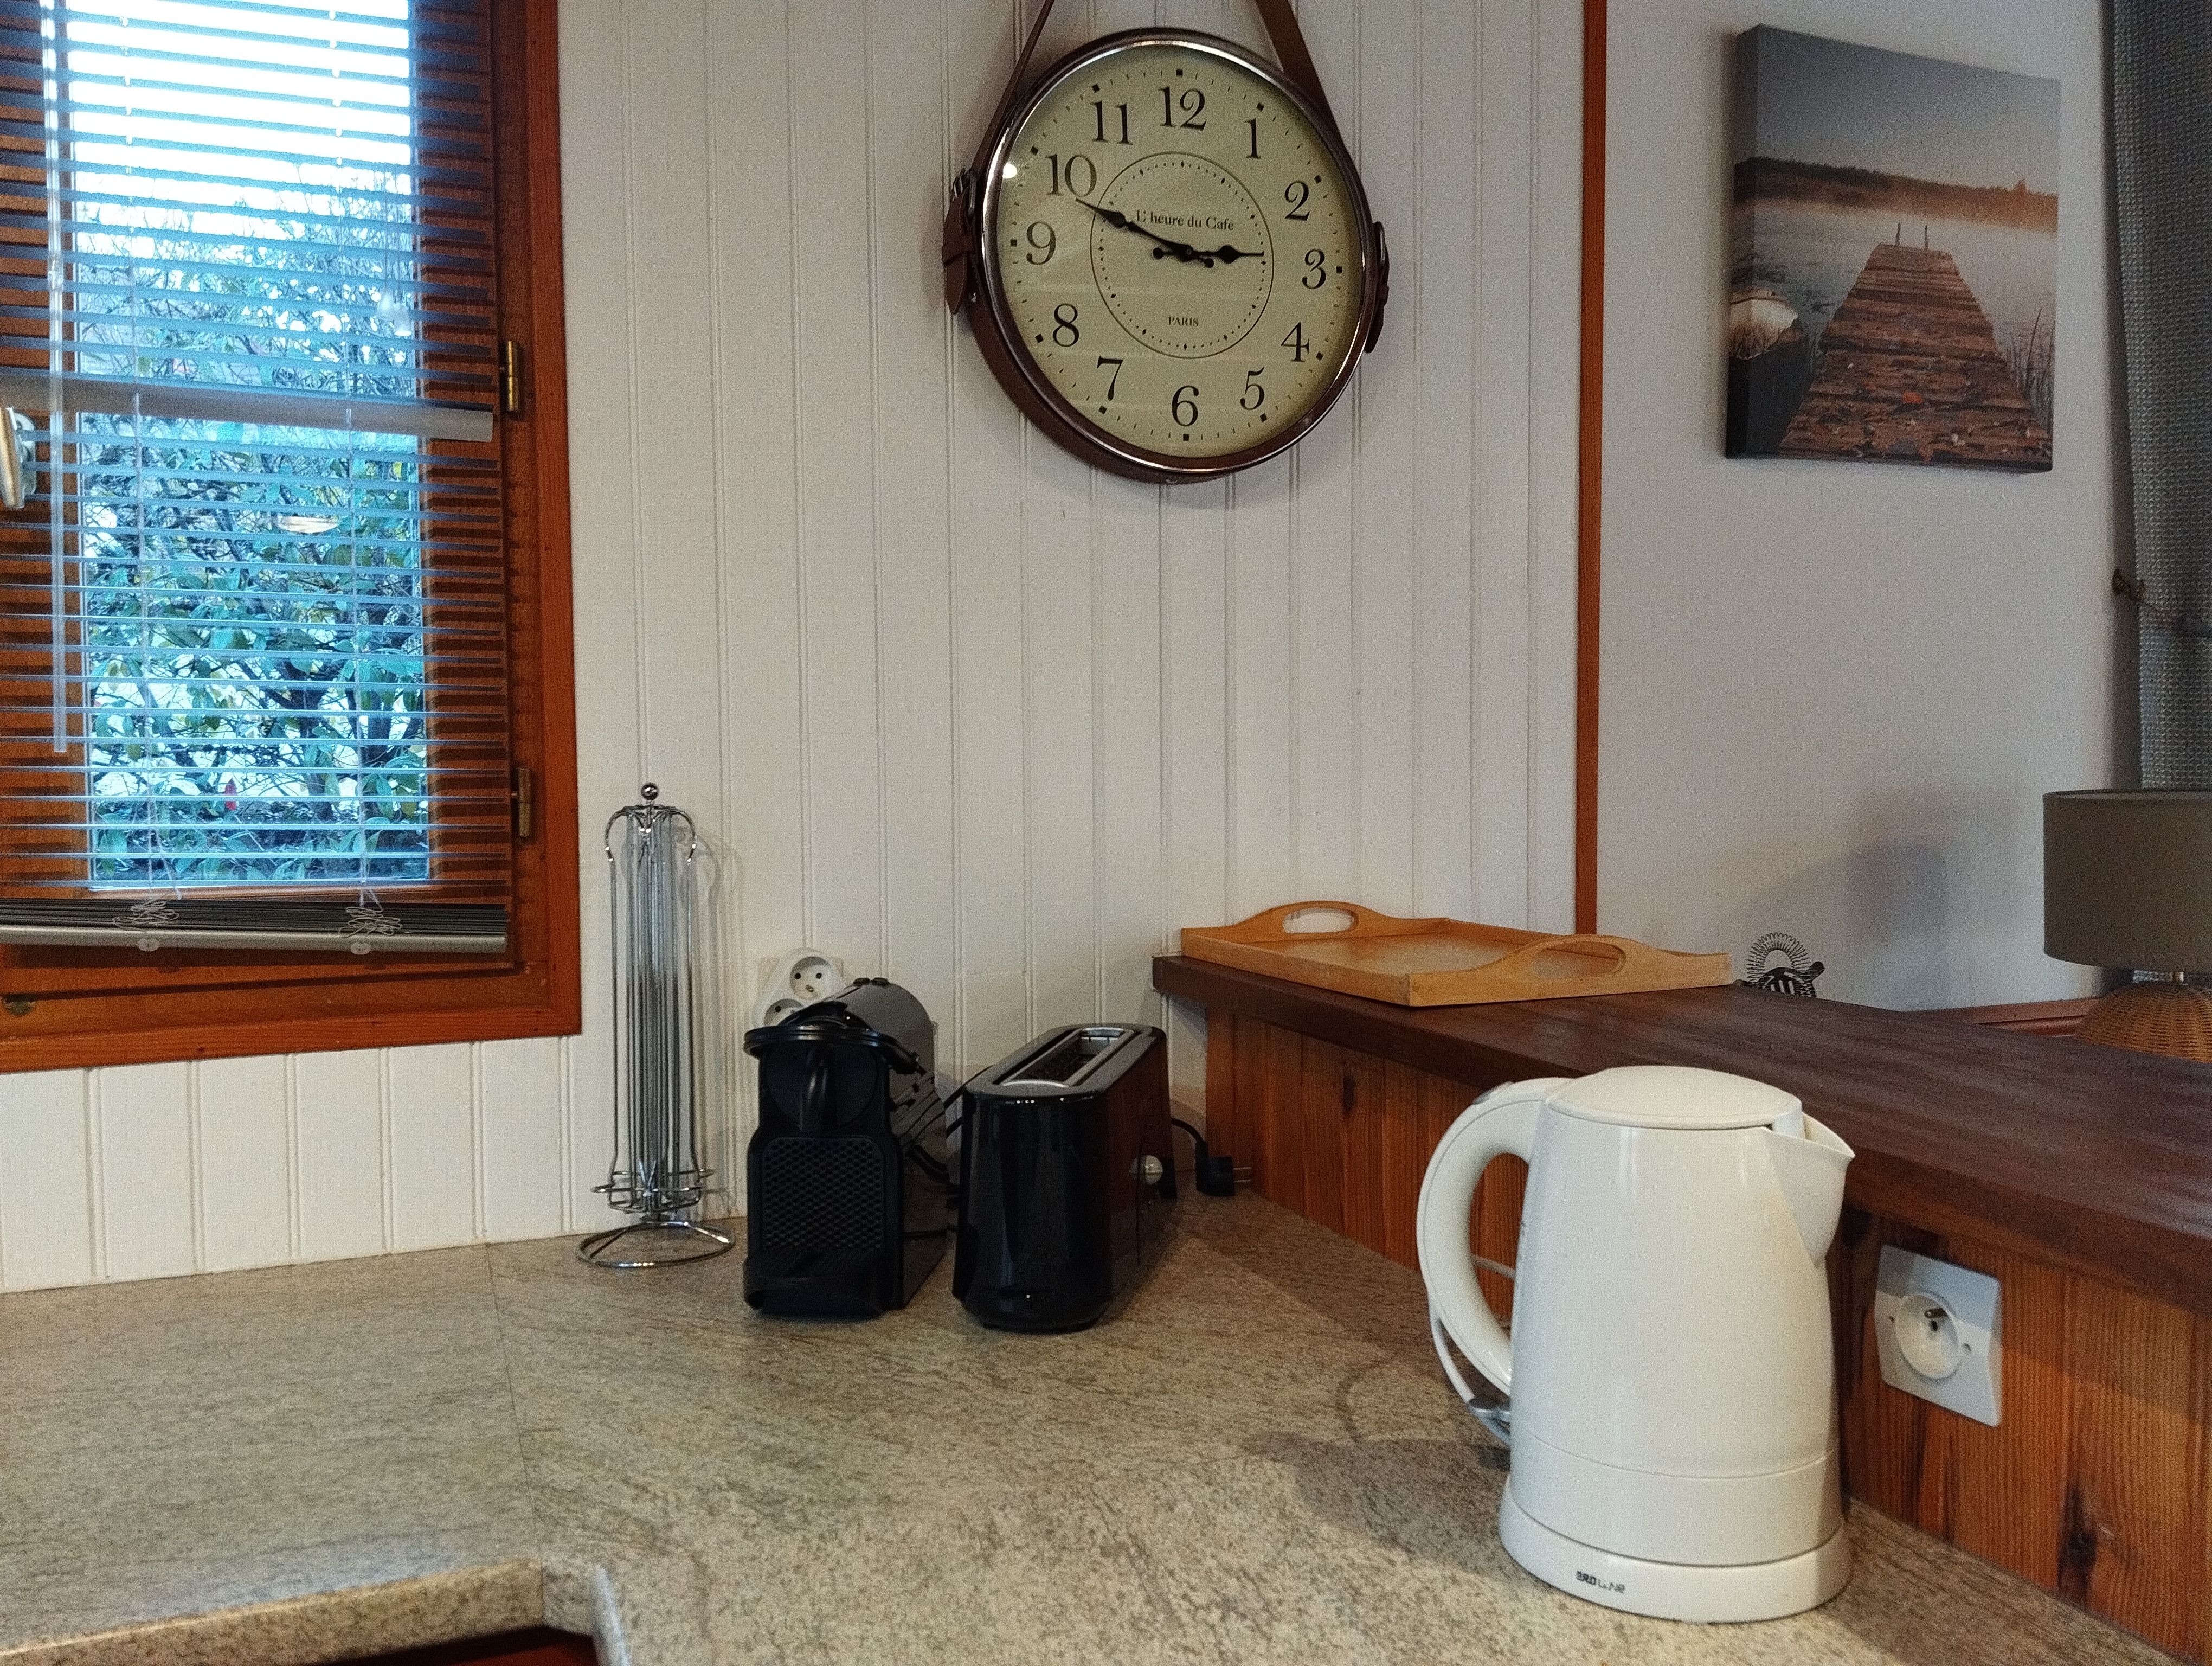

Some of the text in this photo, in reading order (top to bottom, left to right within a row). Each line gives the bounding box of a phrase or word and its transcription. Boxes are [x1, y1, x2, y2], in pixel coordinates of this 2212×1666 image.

[1090, 100, 1134, 145] 11
[1158, 86, 1207, 131] 12
[1246, 118, 1262, 159] 1
[1044, 153, 1097, 197] 10
[1150, 211, 1184, 226] heure
[1187, 215, 1202, 228] du
[1284, 181, 1310, 221] 2
[1026, 221, 1056, 265] 9
[1302, 249, 1327, 290] 3
[1052, 303, 1080, 347] 8
[1168, 316, 1199, 326] PARIS
[1281, 322, 1311, 363] 4
[1096, 356, 1123, 401] 7
[1239, 367, 1265, 411] 5
[1171, 385, 1199, 427] 6
